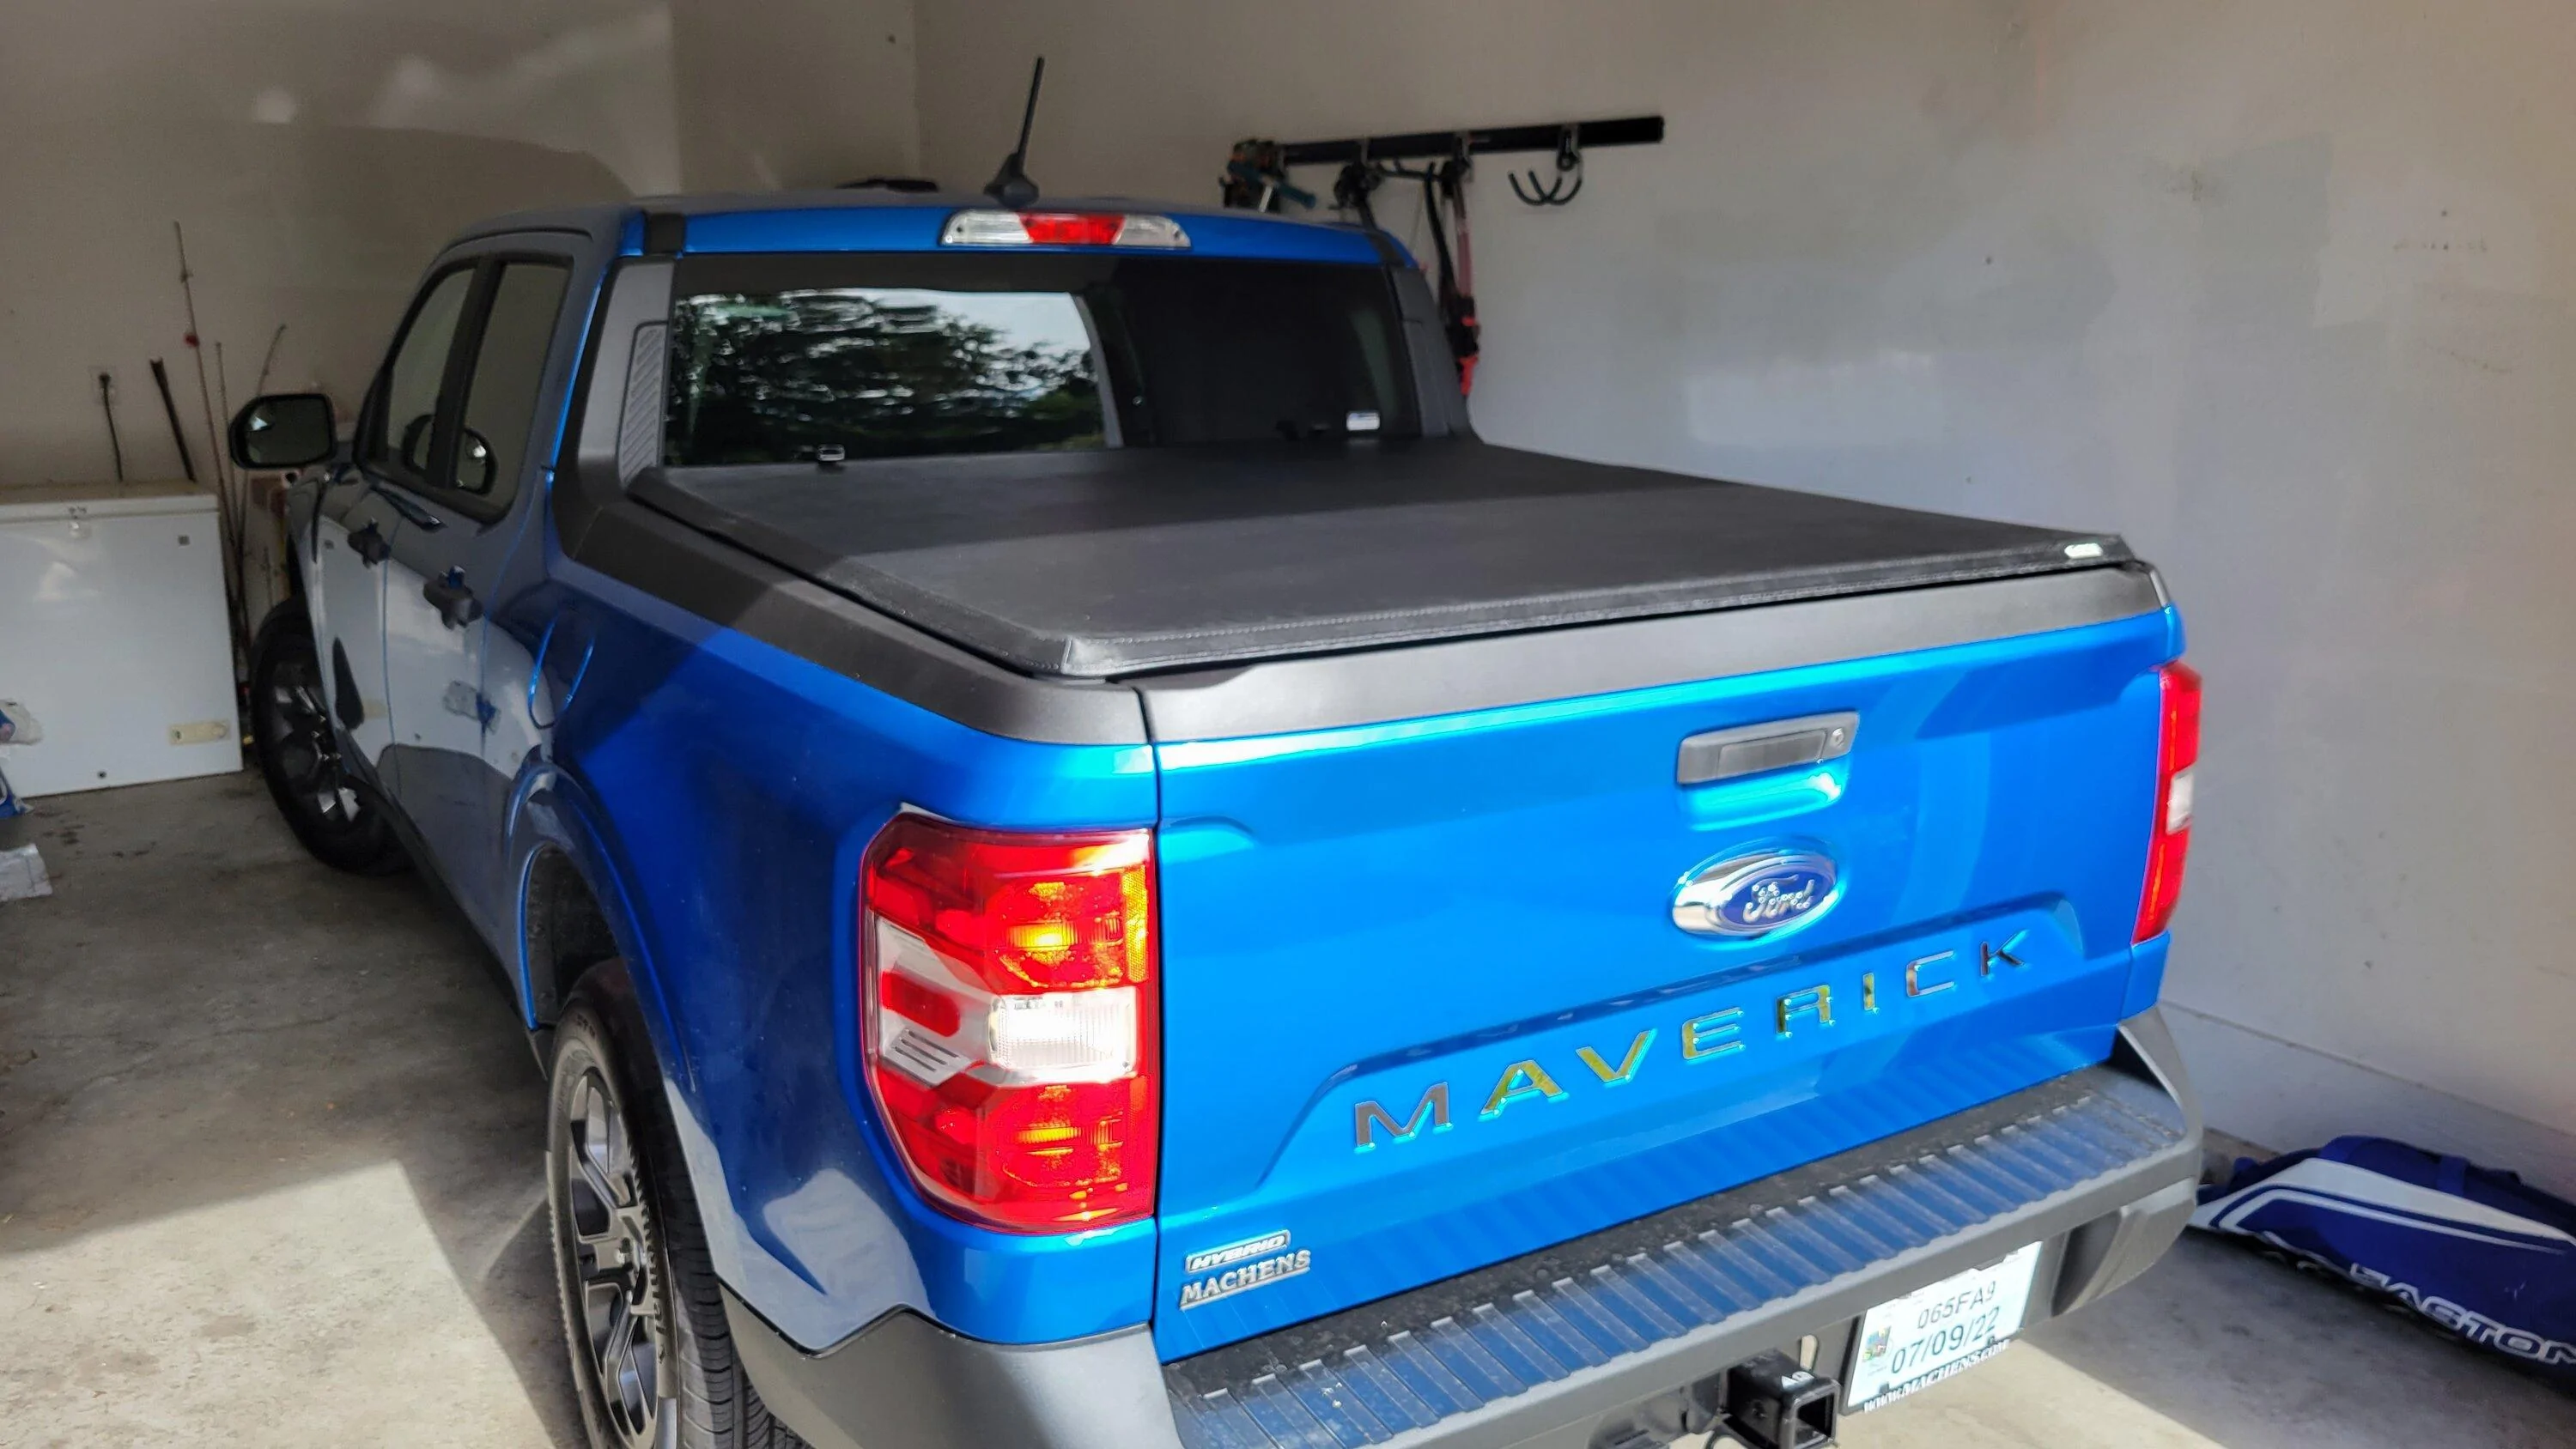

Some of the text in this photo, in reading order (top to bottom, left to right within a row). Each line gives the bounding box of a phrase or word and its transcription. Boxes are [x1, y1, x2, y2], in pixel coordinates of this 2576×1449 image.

[1743, 874, 1815, 923] Ford
[1354, 929, 2029, 1147] MAVERICK
[1182, 1250, 1311, 1305] MACHENS
[1190, 1234, 1286, 1270] HYBRID
[1917, 1280, 1996, 1330] 065FA9
[1891, 1306, 2001, 1374] 07/09/22
